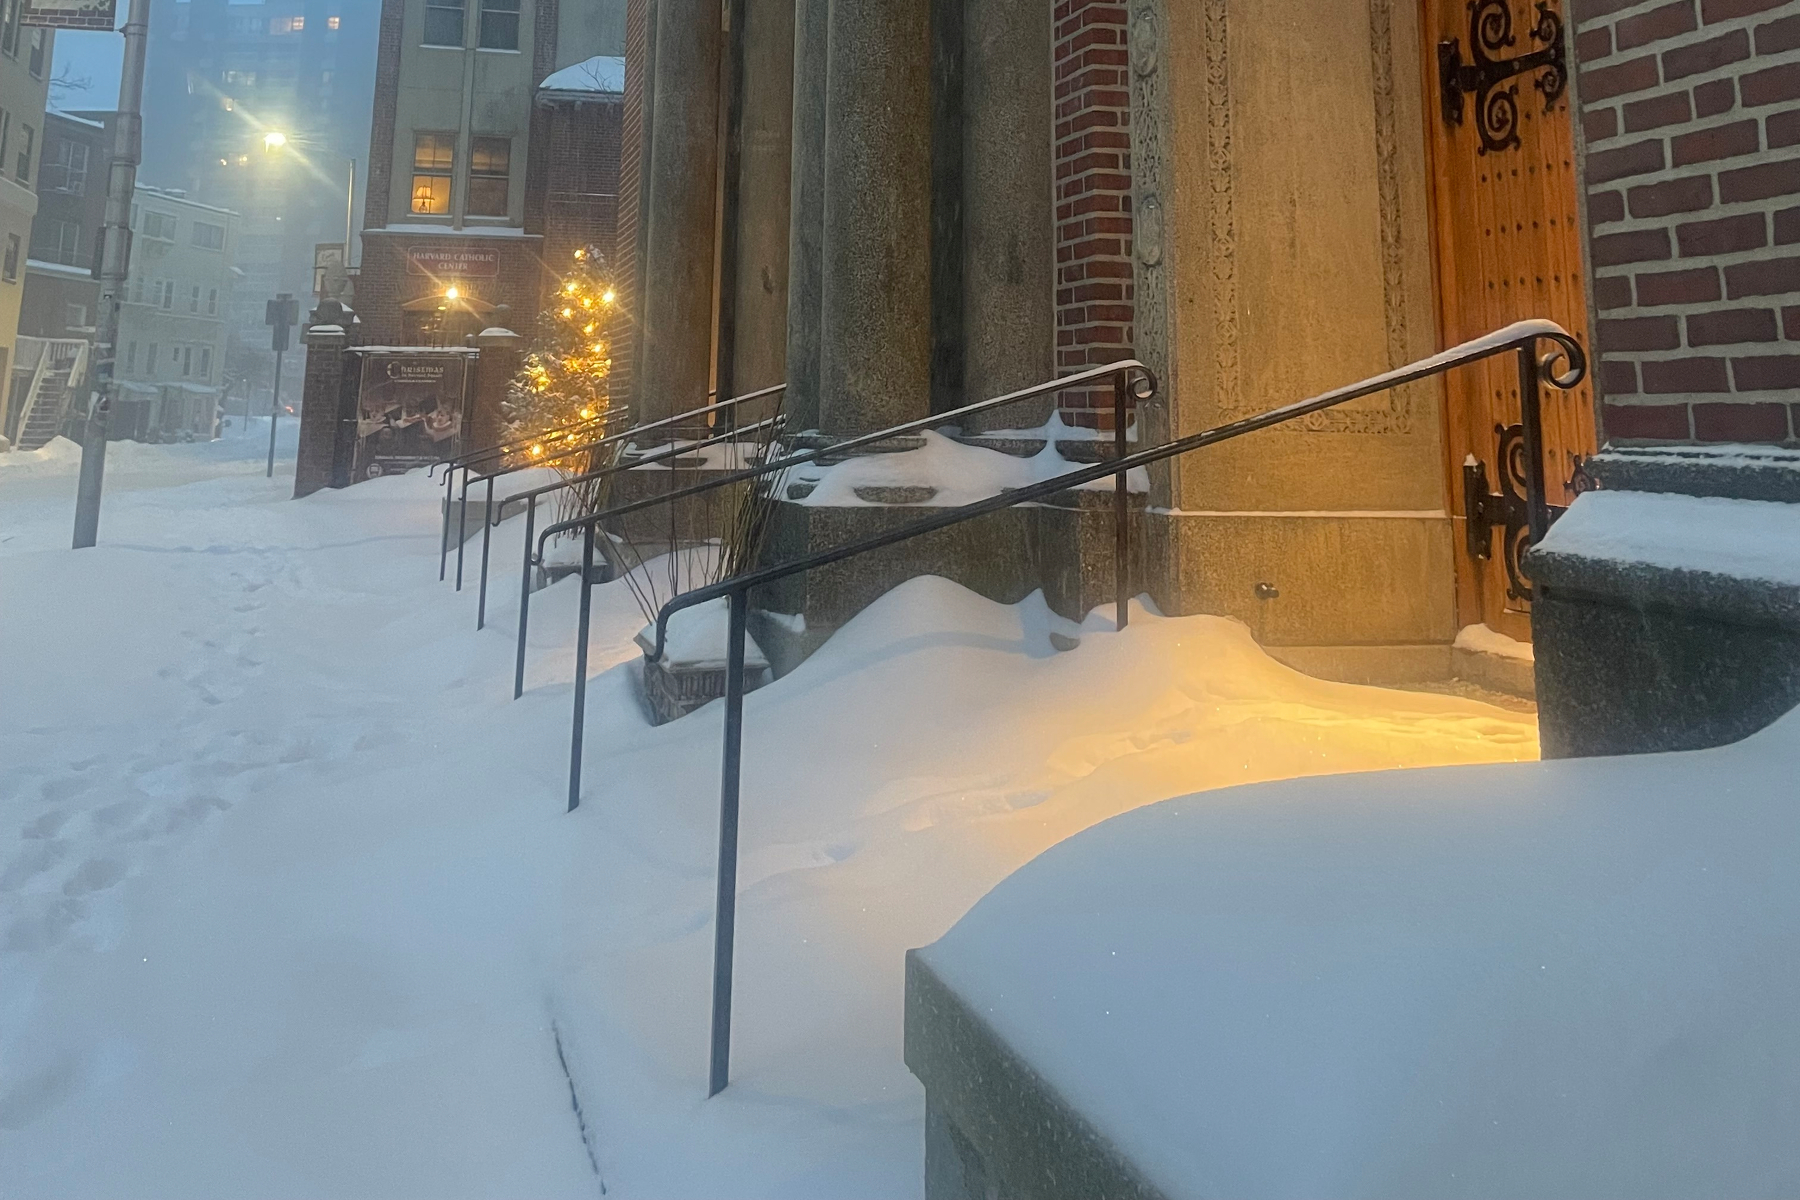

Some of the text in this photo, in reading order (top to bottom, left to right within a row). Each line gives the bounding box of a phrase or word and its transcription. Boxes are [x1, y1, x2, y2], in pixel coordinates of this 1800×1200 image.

[413, 252, 495, 262] HARVARD CATHOLIC
[438, 262, 468, 270] CENTER
